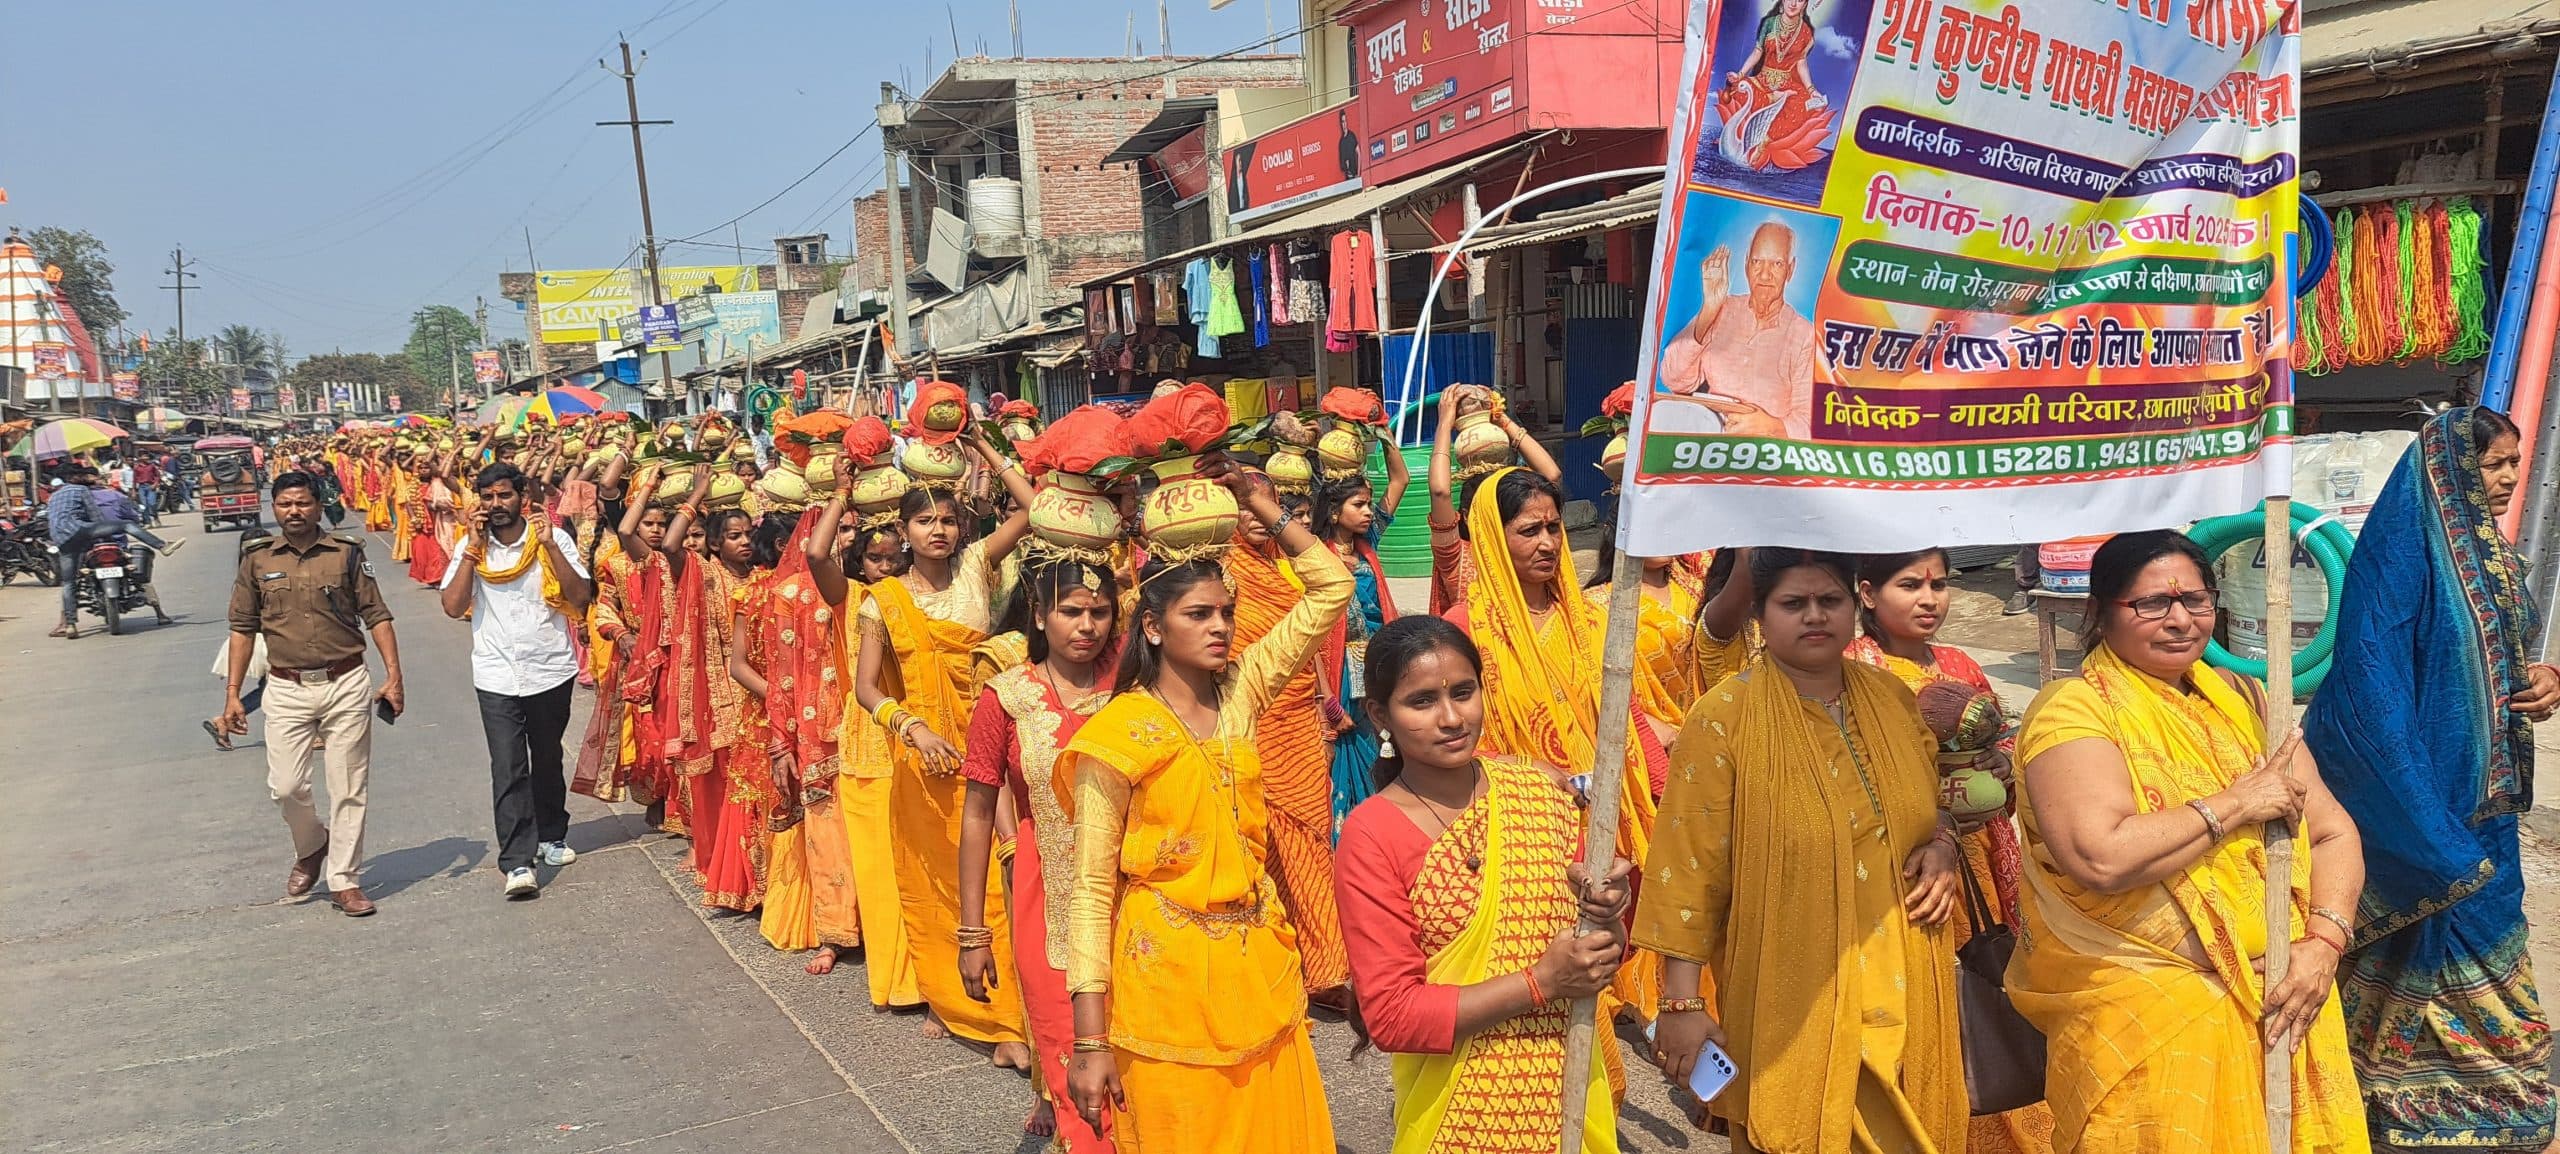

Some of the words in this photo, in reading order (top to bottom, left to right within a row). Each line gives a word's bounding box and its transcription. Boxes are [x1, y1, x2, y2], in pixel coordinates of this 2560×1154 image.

[1367, 19, 1406, 84] सुमन
[1422, 29, 1432, 54] &
[1875, 0, 1933, 68] 24
[1933, 4, 2041, 103] कुण्डीय
[2043, 38, 2122, 122] गायत्री
[1268, 148, 1294, 168] DOLLAR
[1868, 118, 1963, 158] मार्गदर्शक
[1978, 141, 2043, 177] अखिल
[2043, 152, 2081, 187] विश्व
[2123, 203, 2193, 243] मार्च
[1921, 261, 1960, 294] मेन
[2083, 271, 2133, 291] पम्प
[2135, 262, 2150, 291] से
[1824, 320, 1875, 371] इस
[1871, 329, 1923, 372] यज्ञ
[1914, 320, 1958, 372] में
[1943, 333, 2010, 371] भाग
[2006, 321, 2068, 369] लेने
[2069, 316, 2097, 369] के
[2098, 316, 2147, 369] लिए
[2150, 328, 2206, 369] आपका
[1949, 392, 2043, 427] गायत्री
